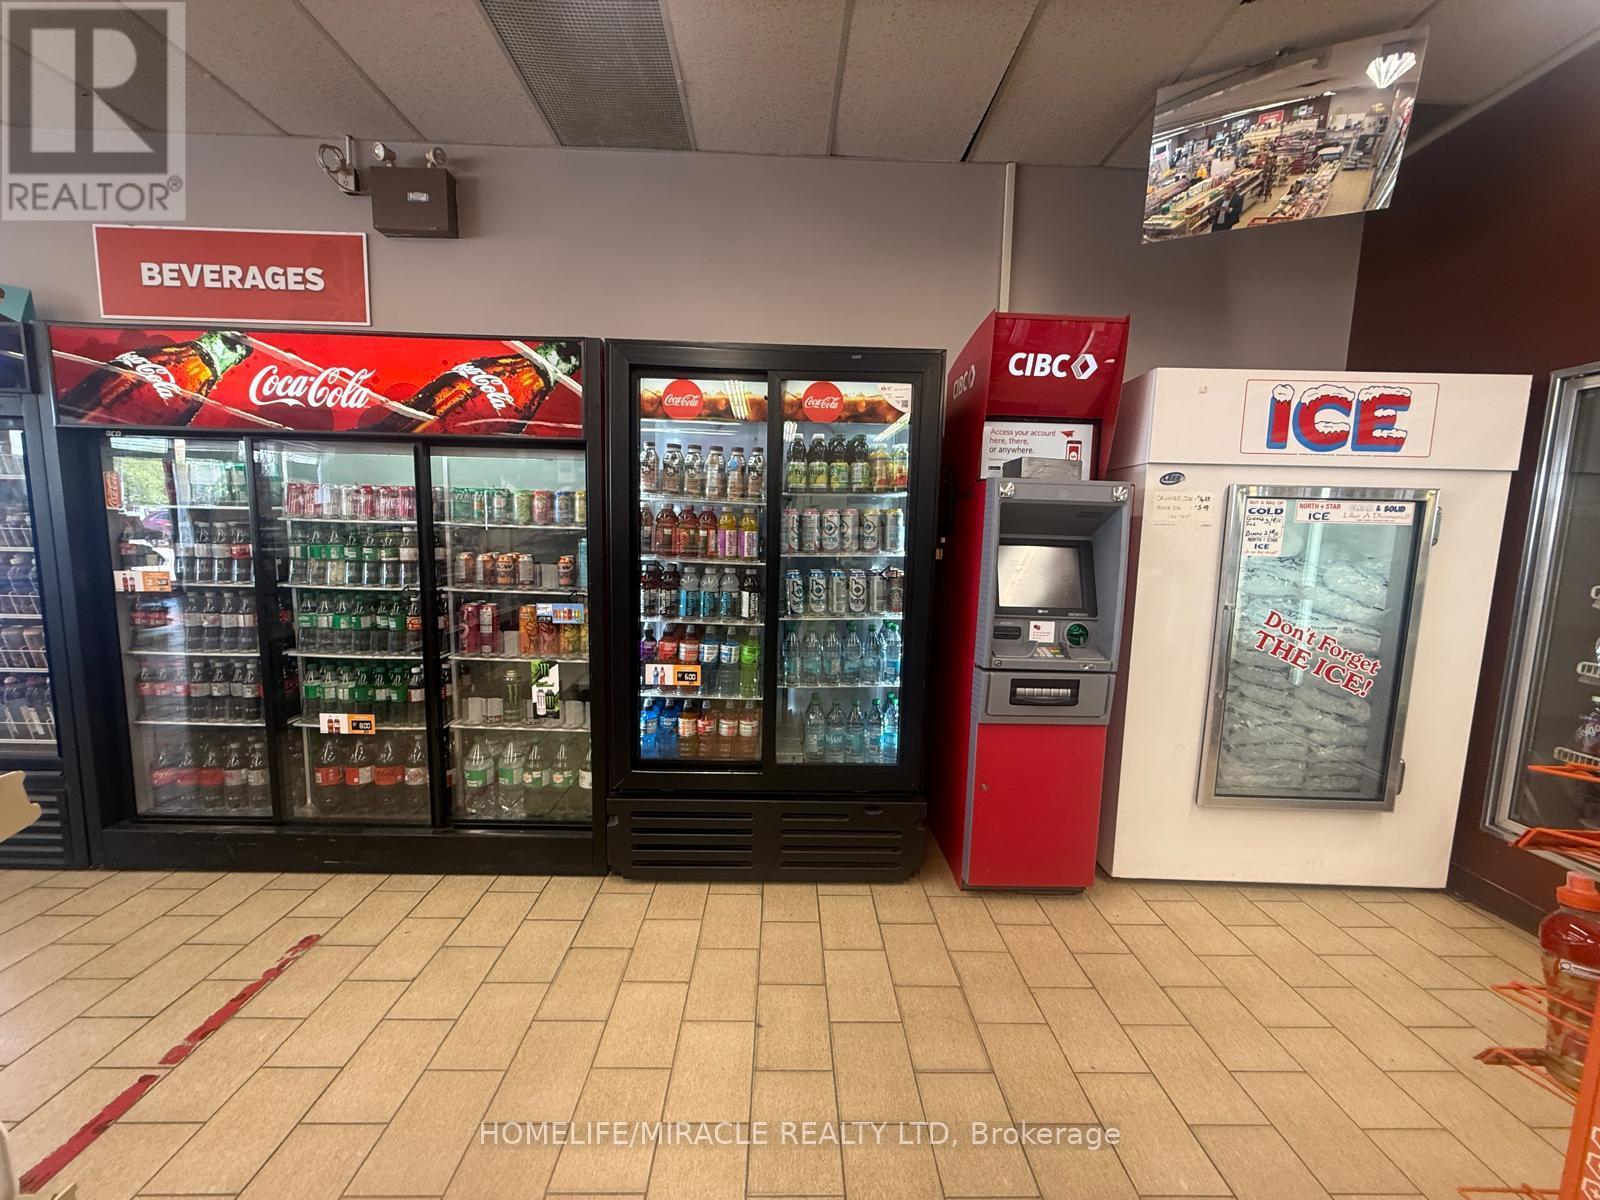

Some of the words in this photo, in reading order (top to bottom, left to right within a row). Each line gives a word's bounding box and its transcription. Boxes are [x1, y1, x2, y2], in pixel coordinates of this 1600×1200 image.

[140, 262, 326, 291] BEVERAGES
[1008, 352, 1071, 378] CIBC
[248, 365, 376, 408] Coca-Cola
[953, 371, 969, 400] CIBC
[664, 393, 700, 407] Coca-Cola
[804, 396, 840, 409] Coca-Cola
[1266, 384, 1412, 453] ICE
[989, 437, 1007, 445] here,
[998, 447, 1034, 455] anywhere.
[1248, 507, 1284, 515] COLD
[1308, 512, 1330, 520] ICE
[1264, 610, 1317, 646] Don't
[1317, 635, 1381, 675] Forget
[1255, 629, 1312, 670] THE
[1311, 658, 1374, 697] ICE!
